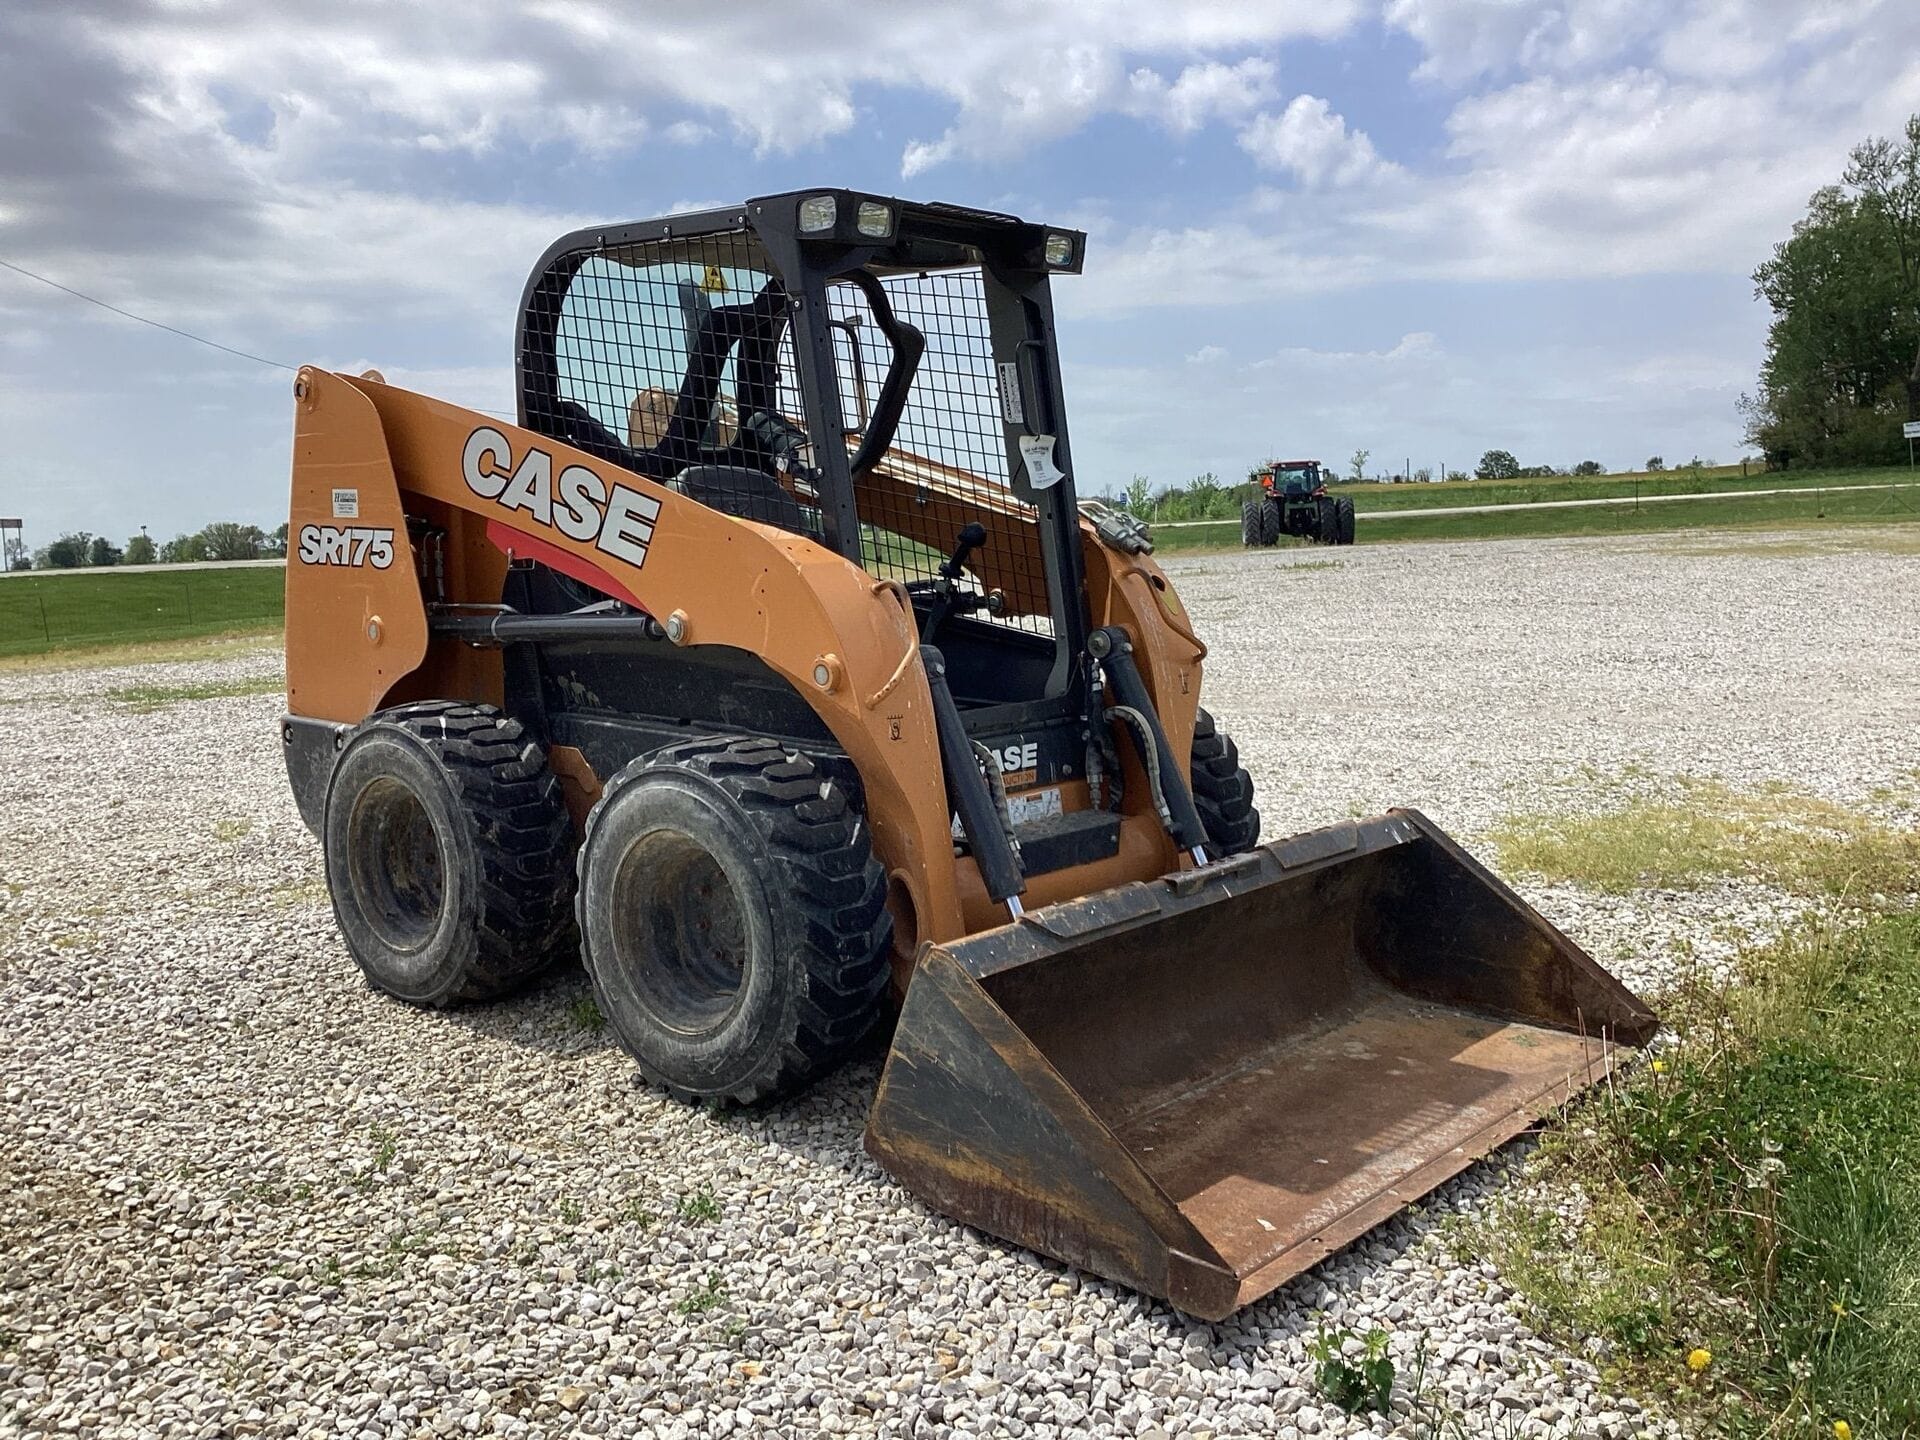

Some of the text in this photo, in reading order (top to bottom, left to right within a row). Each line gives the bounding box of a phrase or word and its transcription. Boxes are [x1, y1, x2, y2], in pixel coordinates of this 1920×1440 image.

[462, 426, 663, 570] CASE
[298, 524, 395, 570] SR175
[975, 742, 1038, 775] ASE
